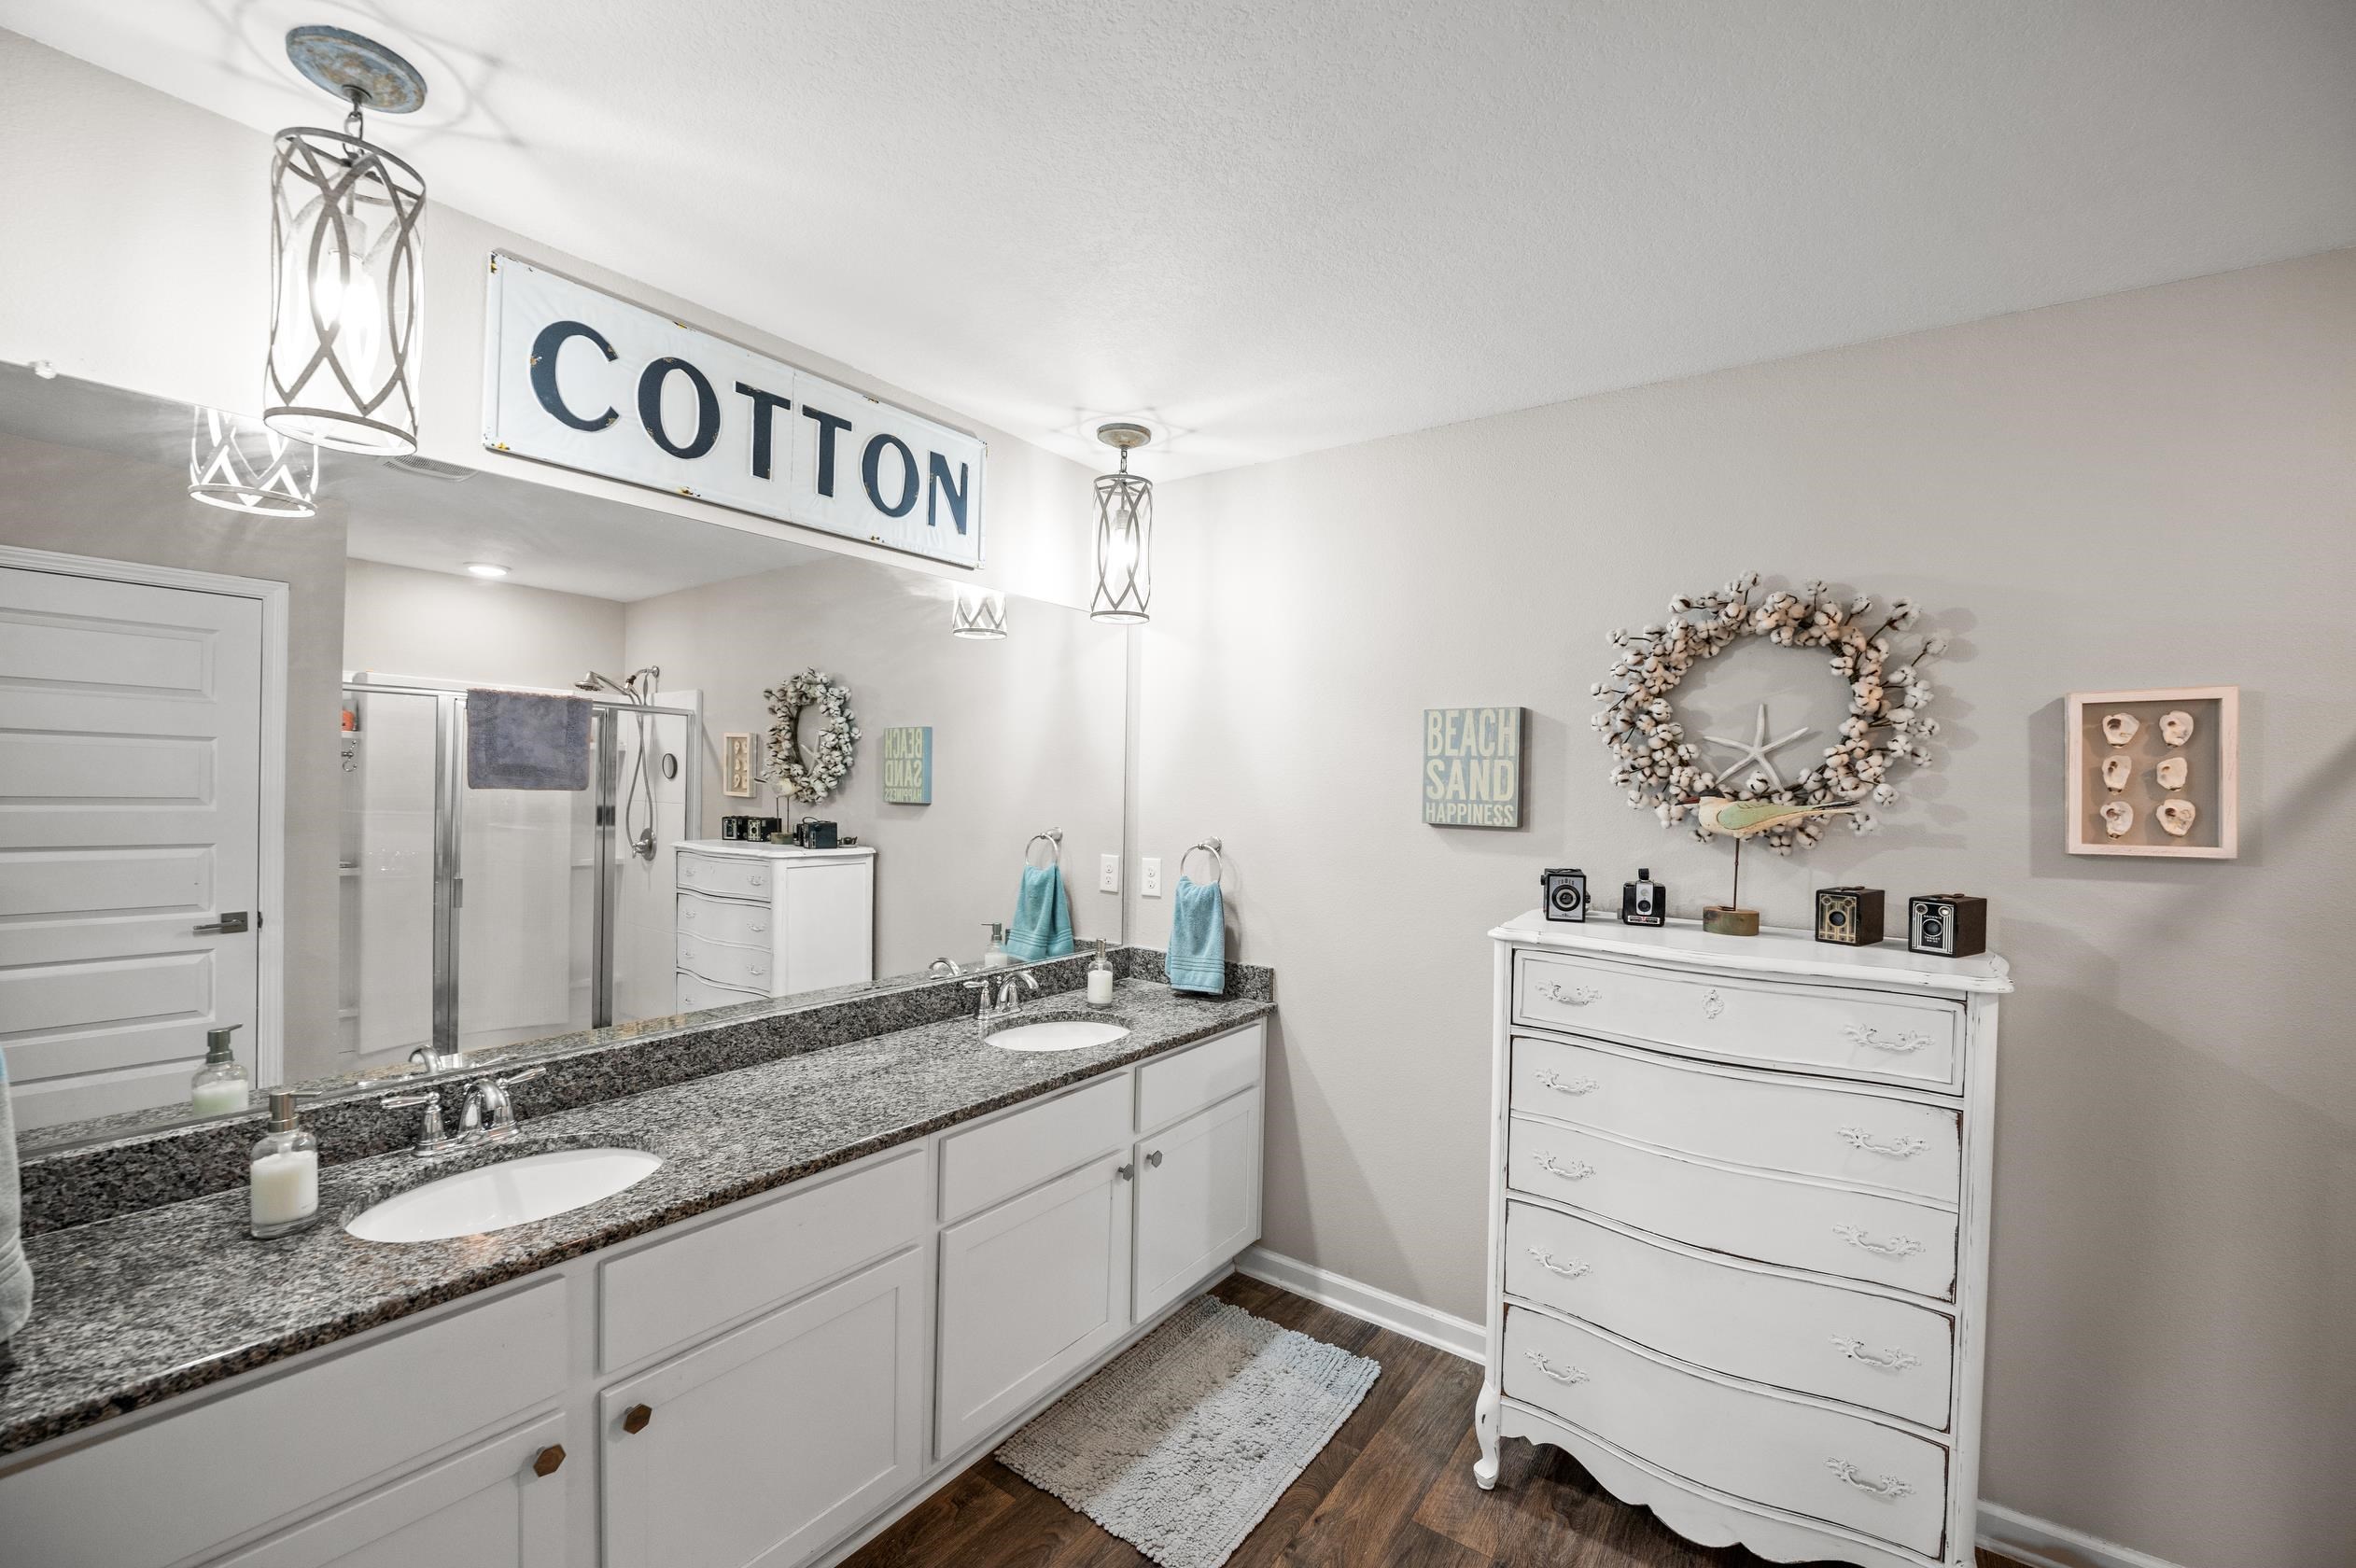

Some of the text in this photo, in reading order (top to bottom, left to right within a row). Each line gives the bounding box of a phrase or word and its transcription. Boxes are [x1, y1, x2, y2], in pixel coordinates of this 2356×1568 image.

[529, 320, 969, 536] COTTON
[1427, 708, 1517, 757] BEACH
[1425, 758, 1515, 802] SAND
[1425, 802, 1514, 825] HAPPINESS
